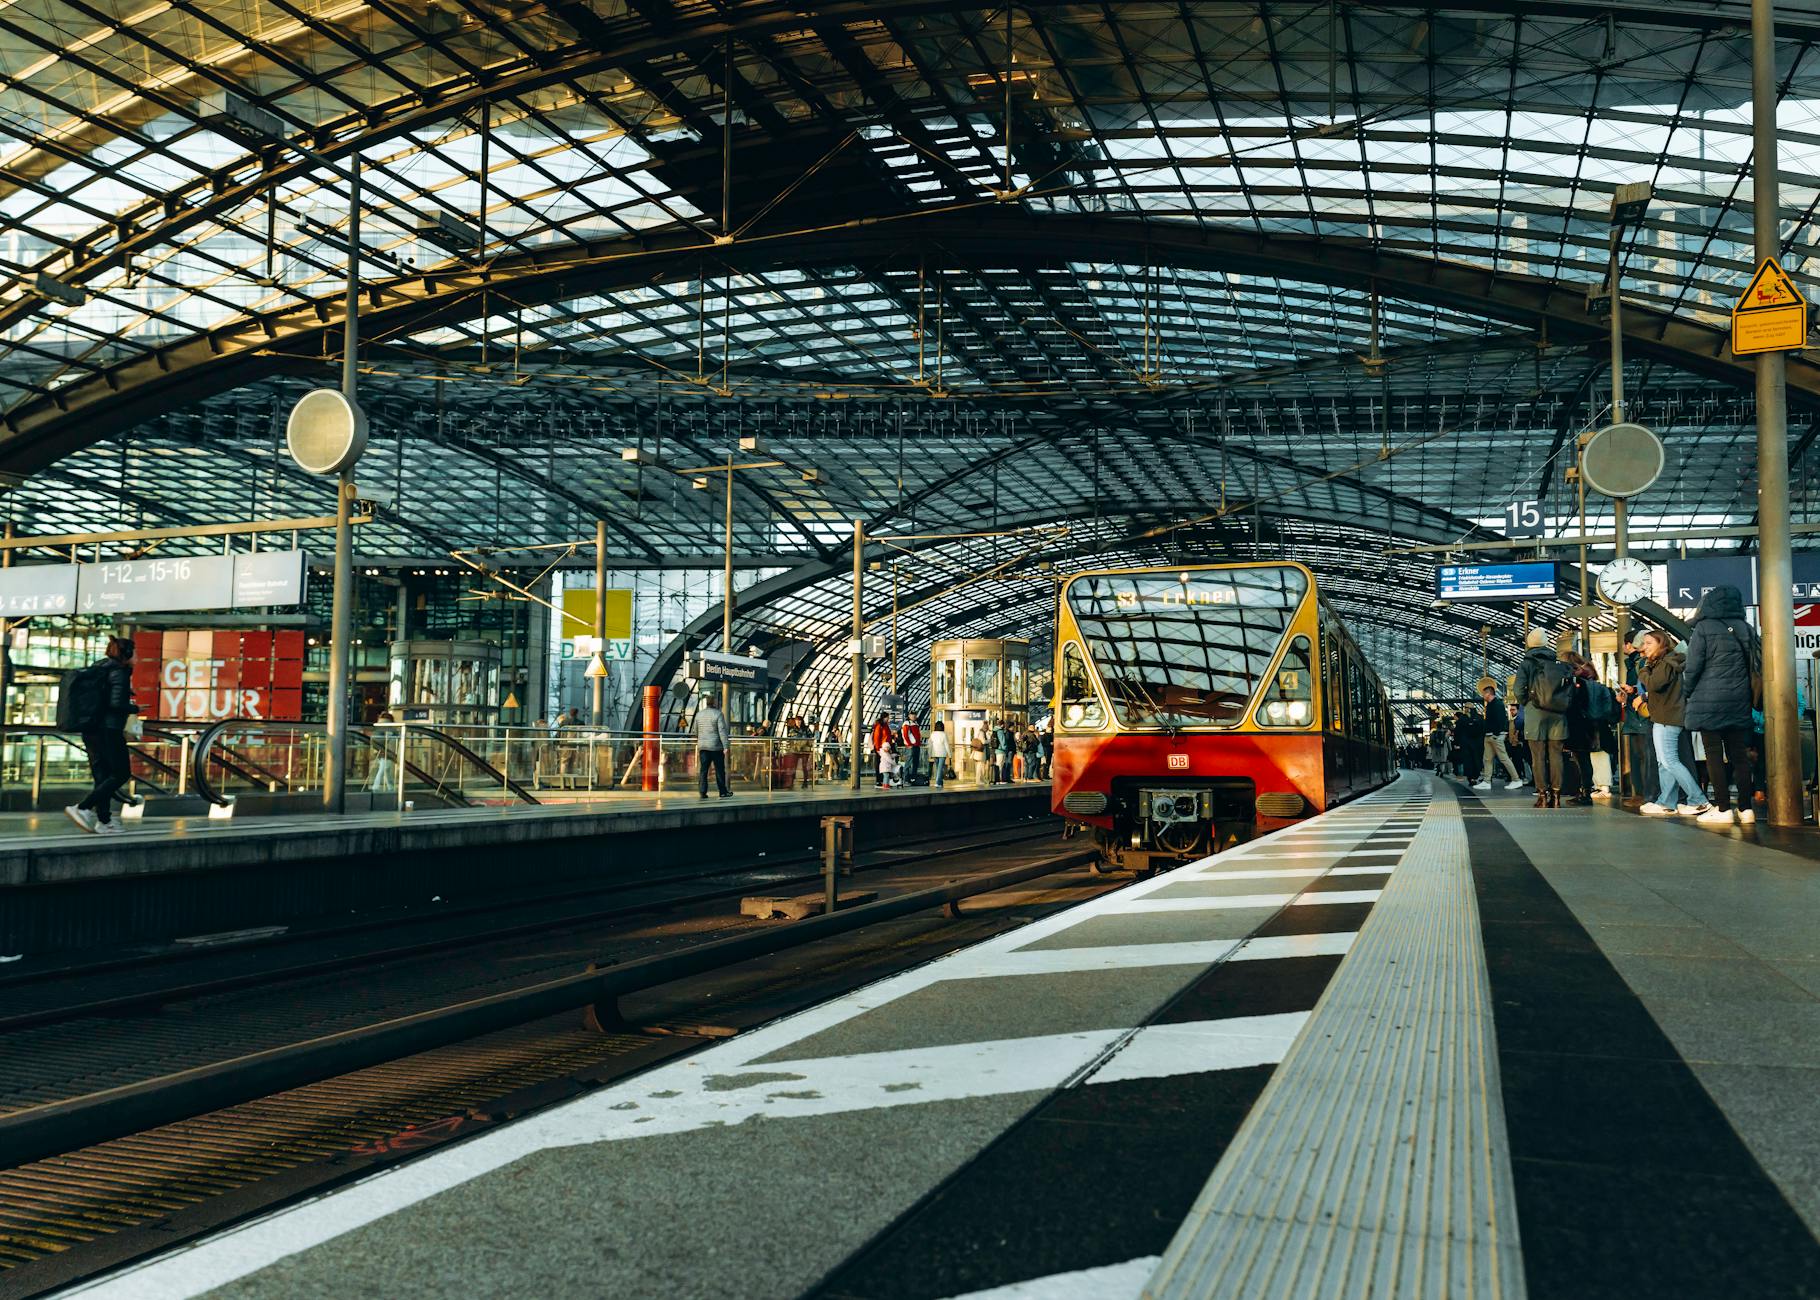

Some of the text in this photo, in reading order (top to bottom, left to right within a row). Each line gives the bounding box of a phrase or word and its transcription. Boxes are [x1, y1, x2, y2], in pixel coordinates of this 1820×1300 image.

[1506, 500, 1540, 528] 15
[101, 563, 133, 584] 1-12
[148, 560, 191, 581] 15-16
[1458, 567, 1480, 575] Erkner
[1117, 591, 1137, 609] S3
[872, 636, 883, 653] F
[164, 660, 225, 688] GET
[706, 663, 755, 679] Berlin Hauptbahnhof
[164, 690, 261, 717] YOUR
[1171, 756, 1186, 767] DB
